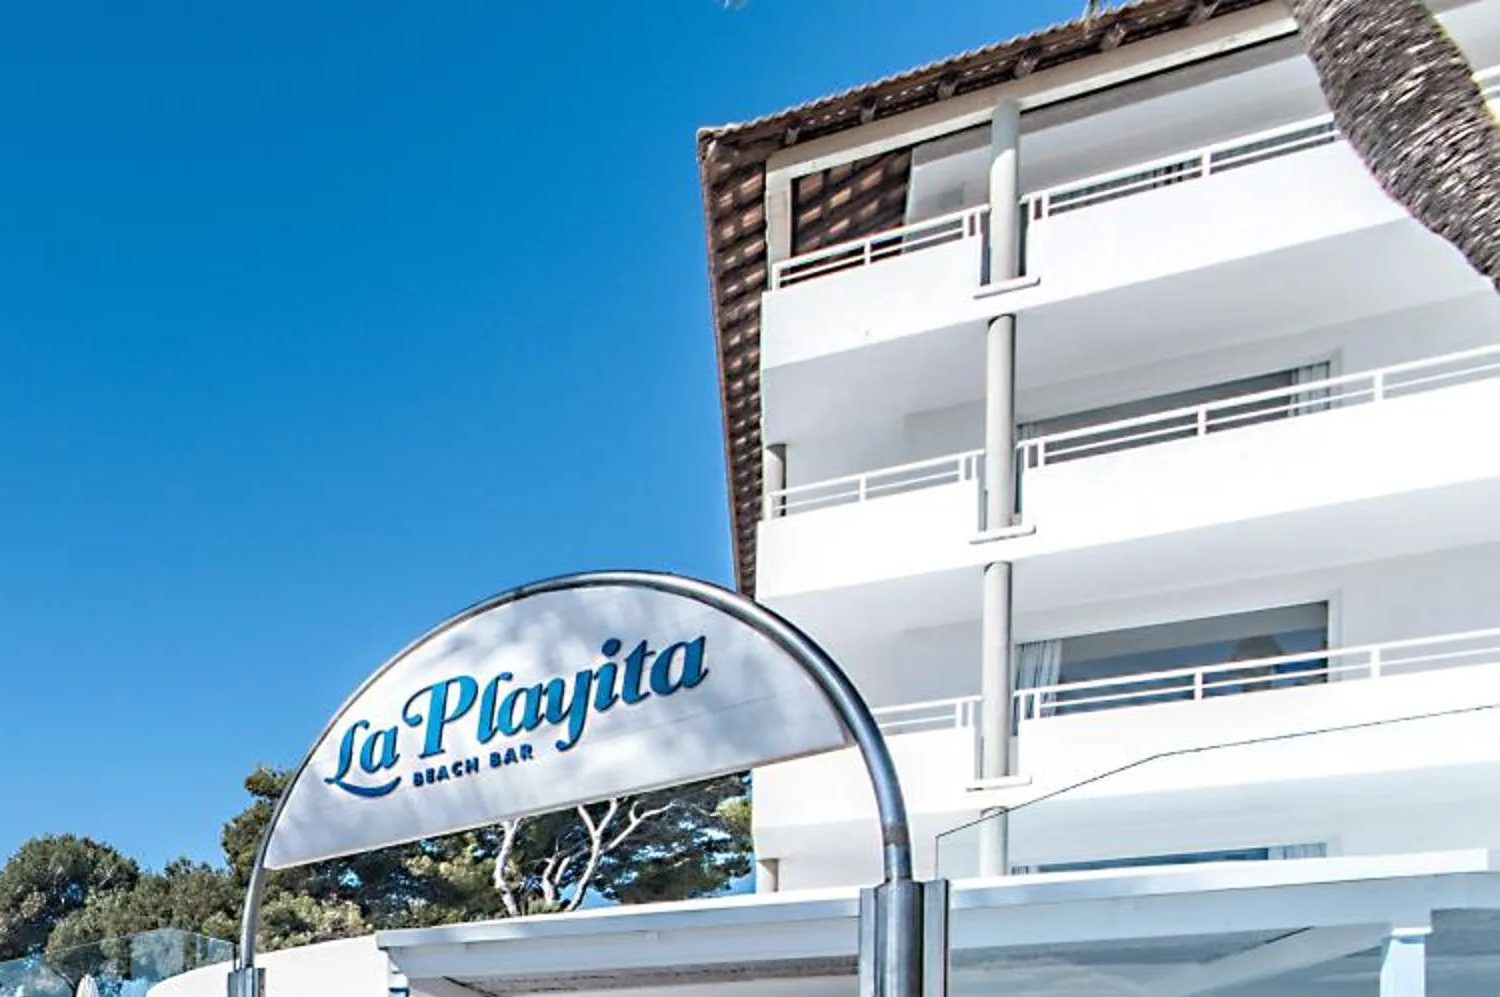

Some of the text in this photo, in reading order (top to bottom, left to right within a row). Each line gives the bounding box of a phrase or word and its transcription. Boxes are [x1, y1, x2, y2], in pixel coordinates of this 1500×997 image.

[324, 635, 709, 798] La Playita
[413, 744, 533, 787] BEACH BAR
